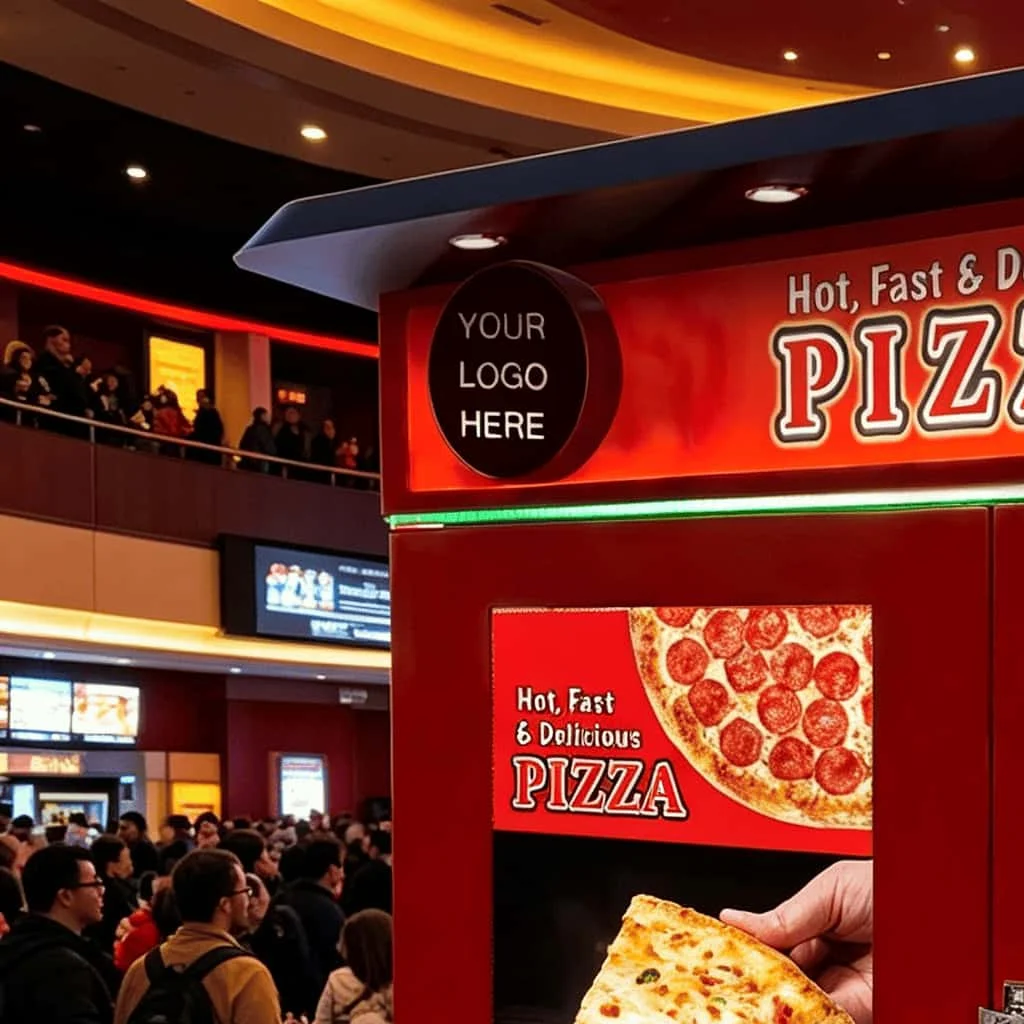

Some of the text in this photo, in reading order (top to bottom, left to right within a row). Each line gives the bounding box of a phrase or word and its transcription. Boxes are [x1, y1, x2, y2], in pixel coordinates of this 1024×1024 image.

[787, 273, 860, 315] Hot,
[871, 264, 943, 305] Fast
[957, 253, 984, 295] &
[458, 312, 545, 340] YOUR
[459, 361, 548, 391] LOGO
[461, 410, 545, 440] HERE
[517, 686, 615, 715] Hot, Fast
[511, 754, 688, 818] PIZZA
